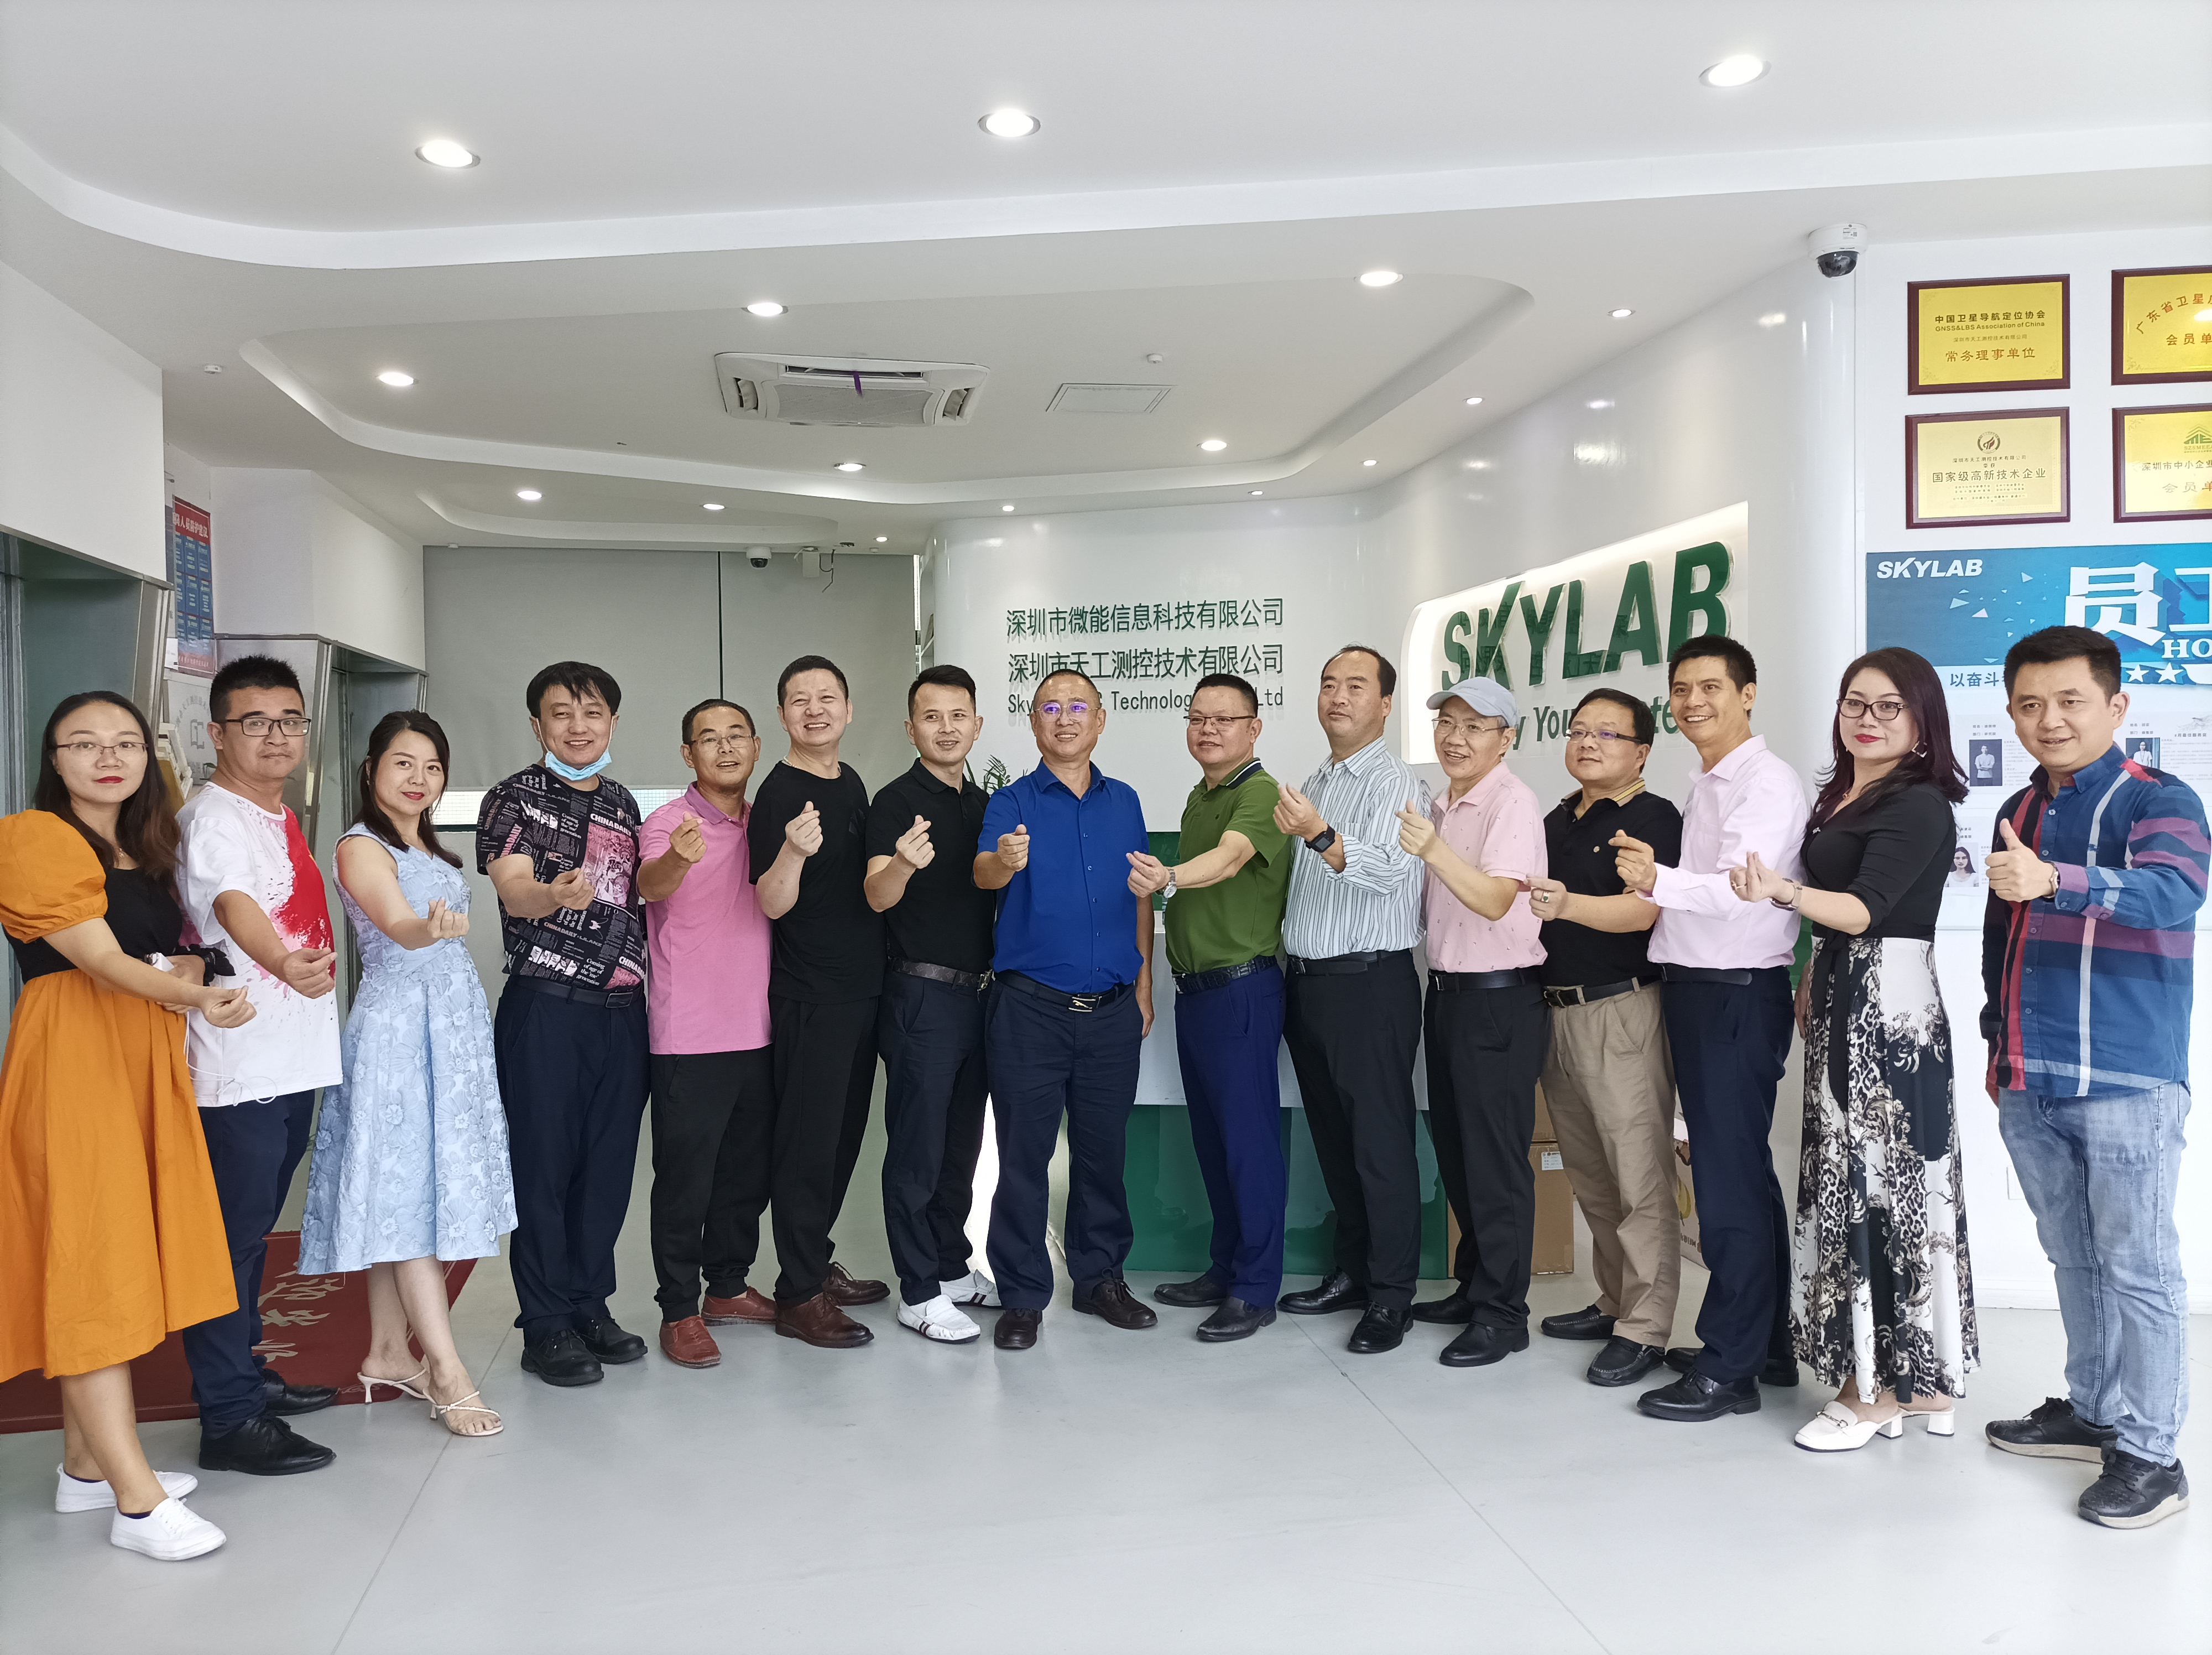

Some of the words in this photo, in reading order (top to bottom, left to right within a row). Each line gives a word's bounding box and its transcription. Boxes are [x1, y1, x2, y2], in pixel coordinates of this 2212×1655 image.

[1936, 310, 2045, 324] 中国卫星导航定位协会
[2136, 293, 2212, 334] 广东省卫星
[2166, 333, 2212, 346] 会员单
[1945, 347, 2036, 362] 常务理事单位
[1933, 468, 2046, 483] 国家级高新技术企业
[1876, 557, 1983, 579] SKYLAB
[1006, 598, 1284, 637] 深圳市微能信息科技有限公司
[1442, 541, 1732, 691] SKYLAB
[1008, 644, 1283, 683] 深圳市天工测控技术有限公司
[1950, 672, 2004, 687] 以奋斗
[1008, 694, 1034, 716] Sky
[1111, 689, 1192, 712] Technolog
[1533, 706, 1575, 742] You
